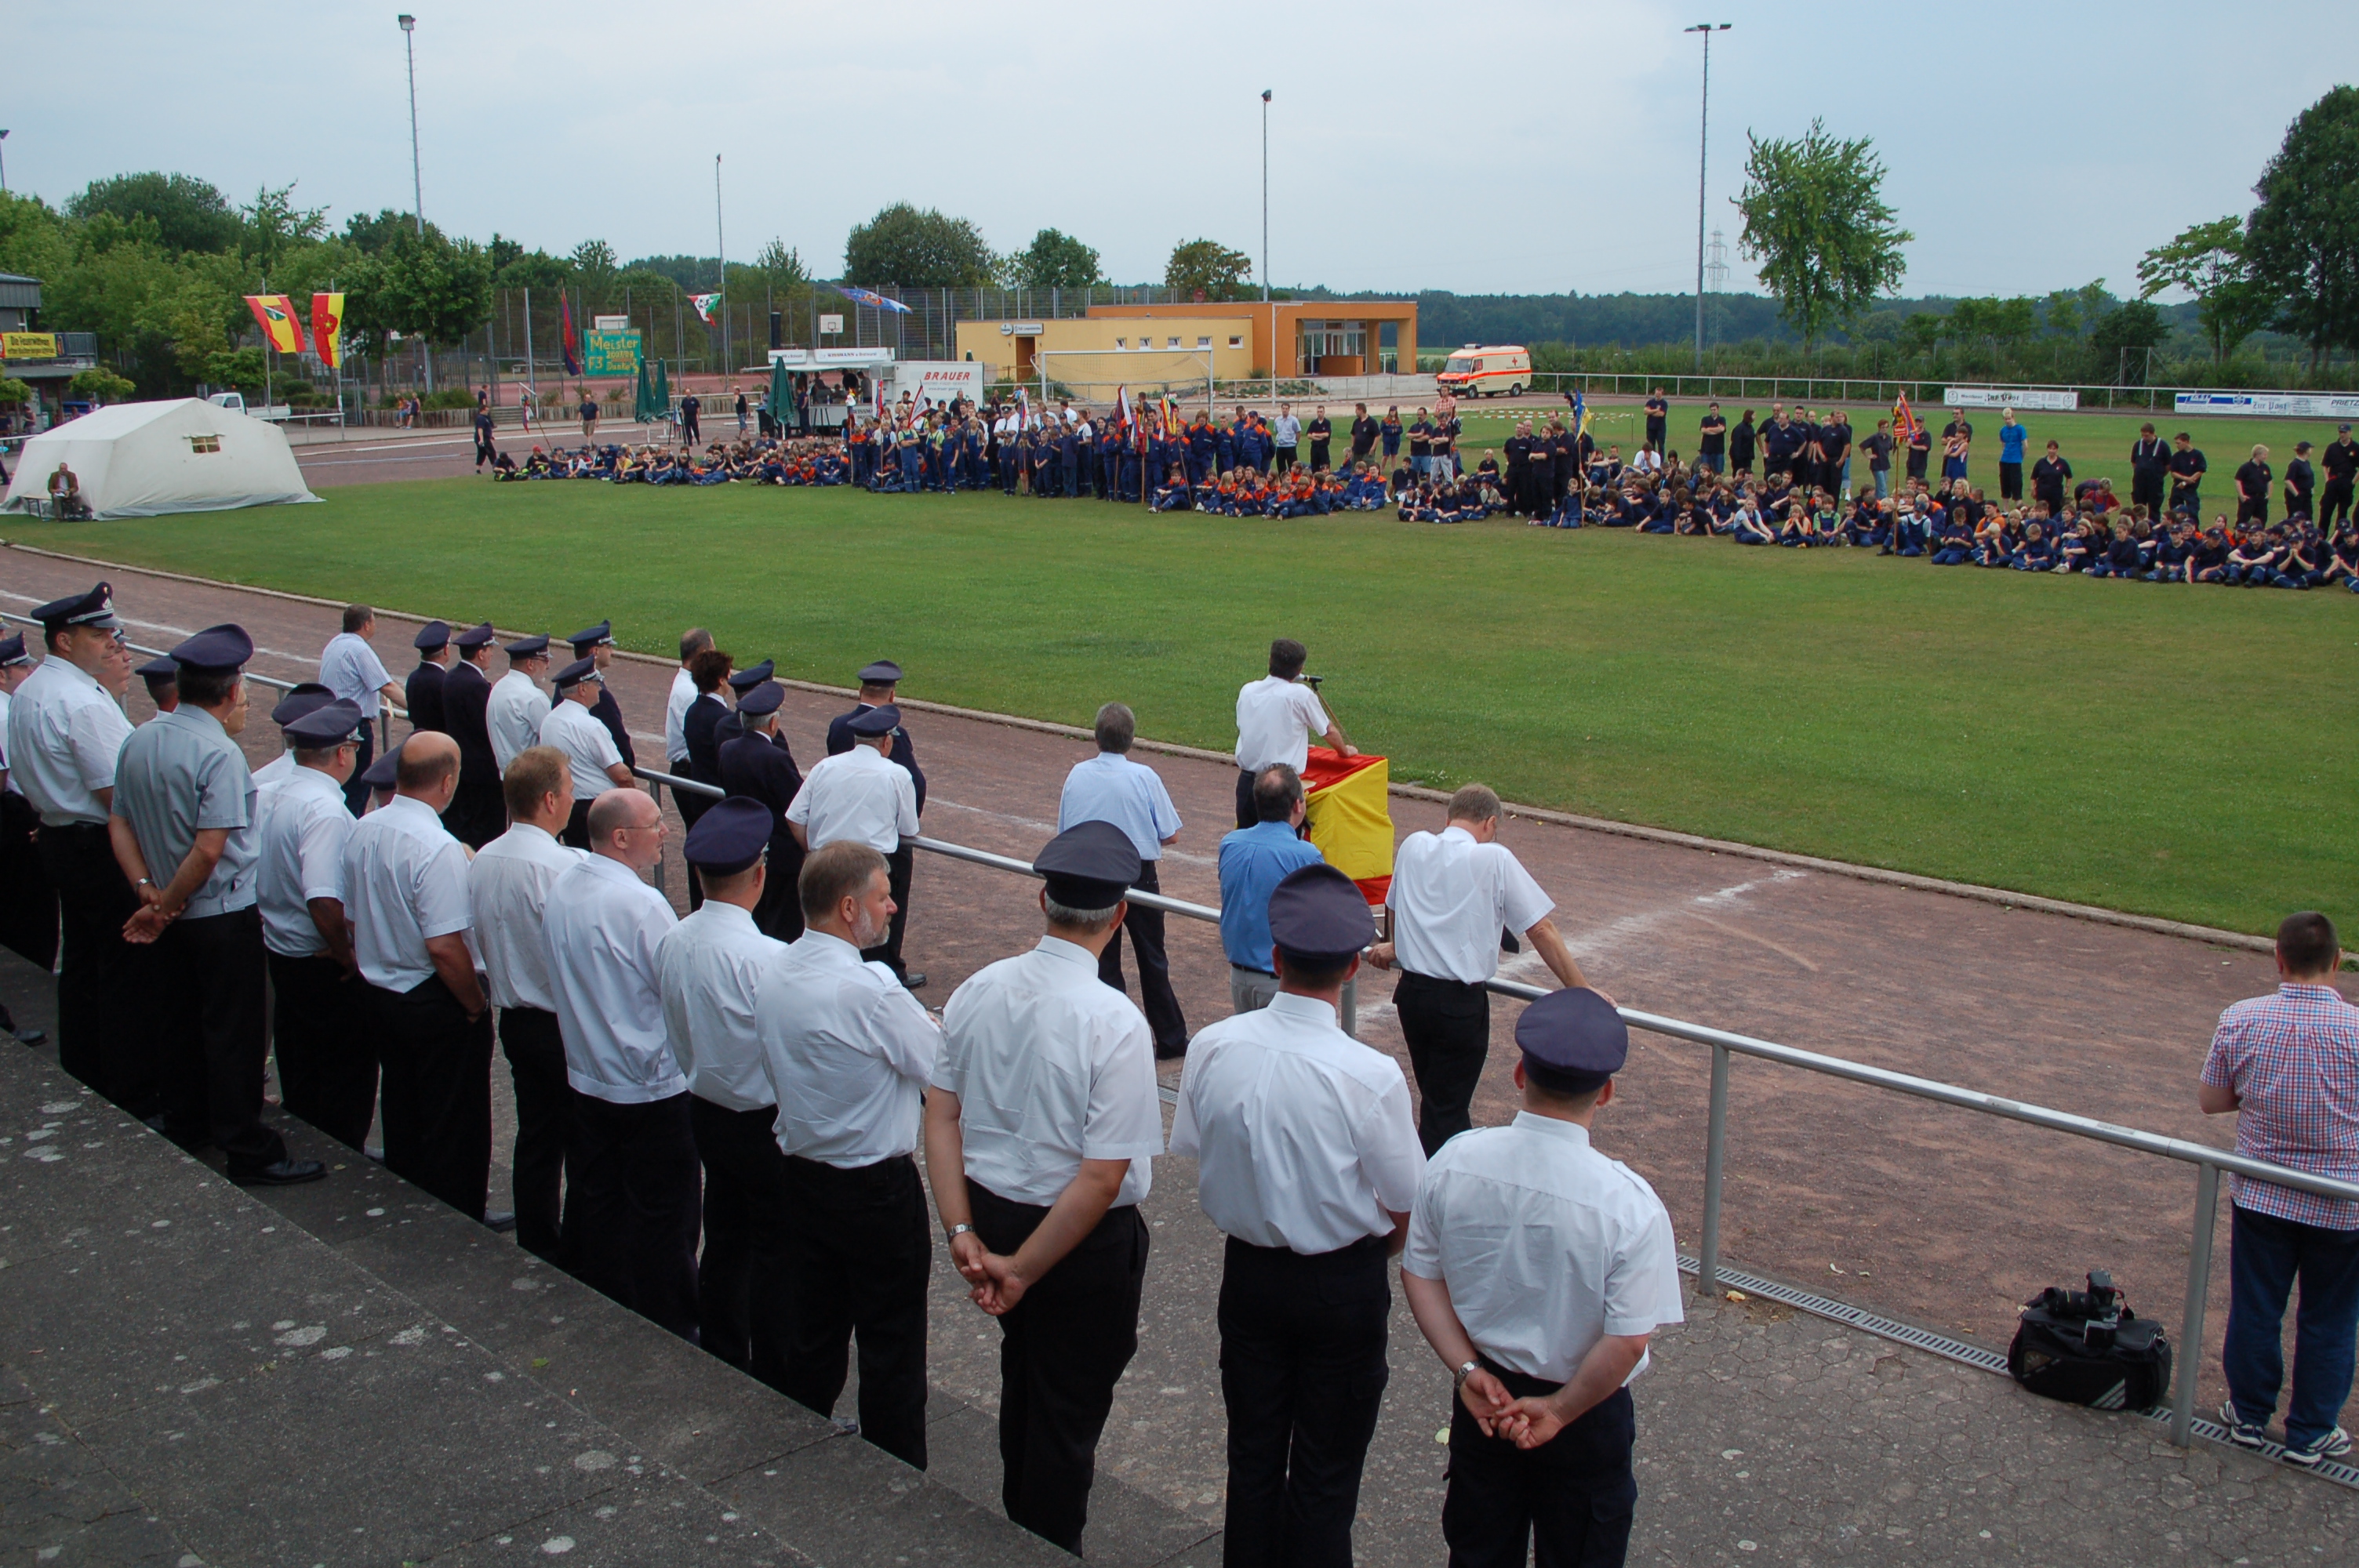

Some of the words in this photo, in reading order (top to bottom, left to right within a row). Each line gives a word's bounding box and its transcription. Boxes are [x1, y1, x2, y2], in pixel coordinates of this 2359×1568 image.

[590, 336, 638, 352] Meister
[924, 372, 970, 380] BRAUER
[2268, 401, 2288, 410] Post
